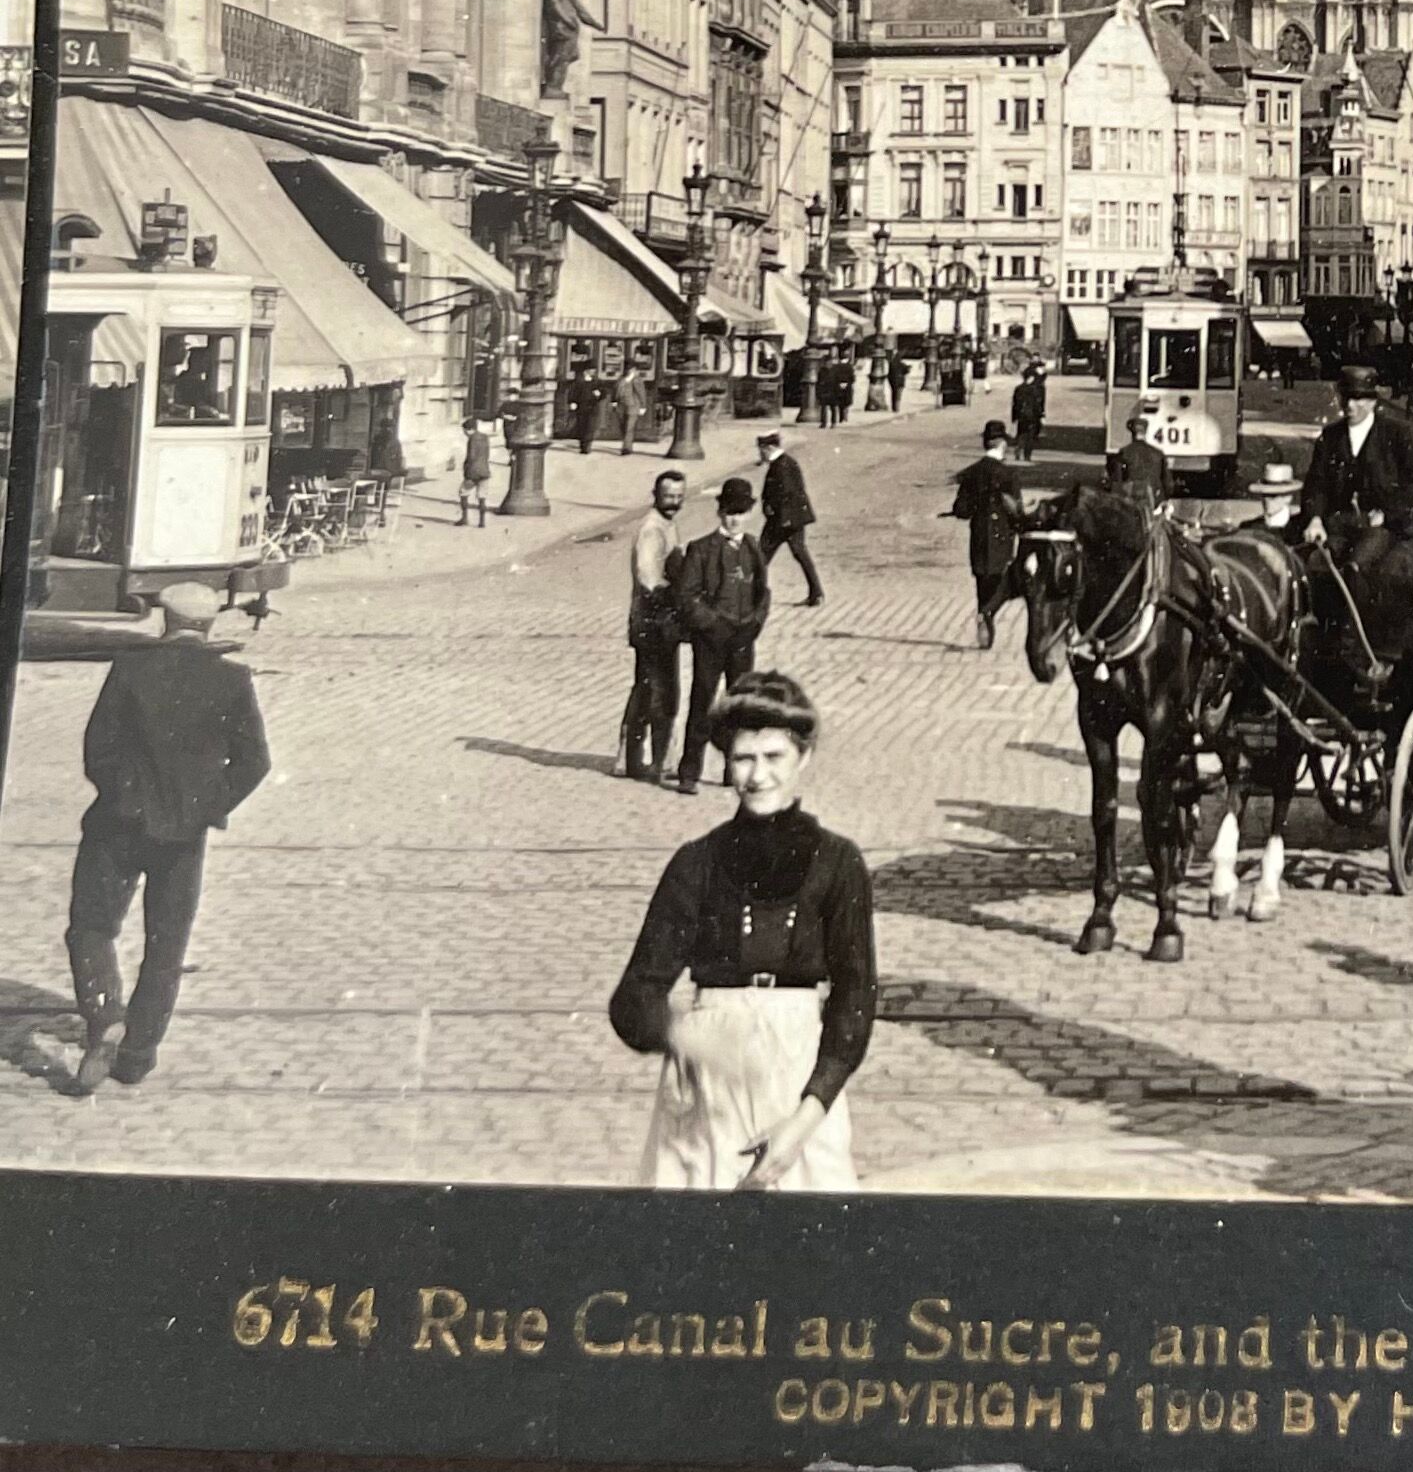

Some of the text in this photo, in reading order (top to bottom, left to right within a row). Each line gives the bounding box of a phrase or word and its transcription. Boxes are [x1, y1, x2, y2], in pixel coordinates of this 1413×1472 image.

[1153, 428, 1192, 445] 401
[233, 1276, 379, 1350] 6714
[411, 1286, 549, 1358] Rue
[573, 1291, 768, 1358] Canal
[794, 1316, 877, 1362] au
[905, 1298, 1121, 1374] Sucre,
[1150, 1315, 1273, 1370] and
[1302, 1314, 1409, 1371] the
[775, 1379, 1106, 1432] COPYRIGHT
[1281, 1389, 1361, 1438] BY
